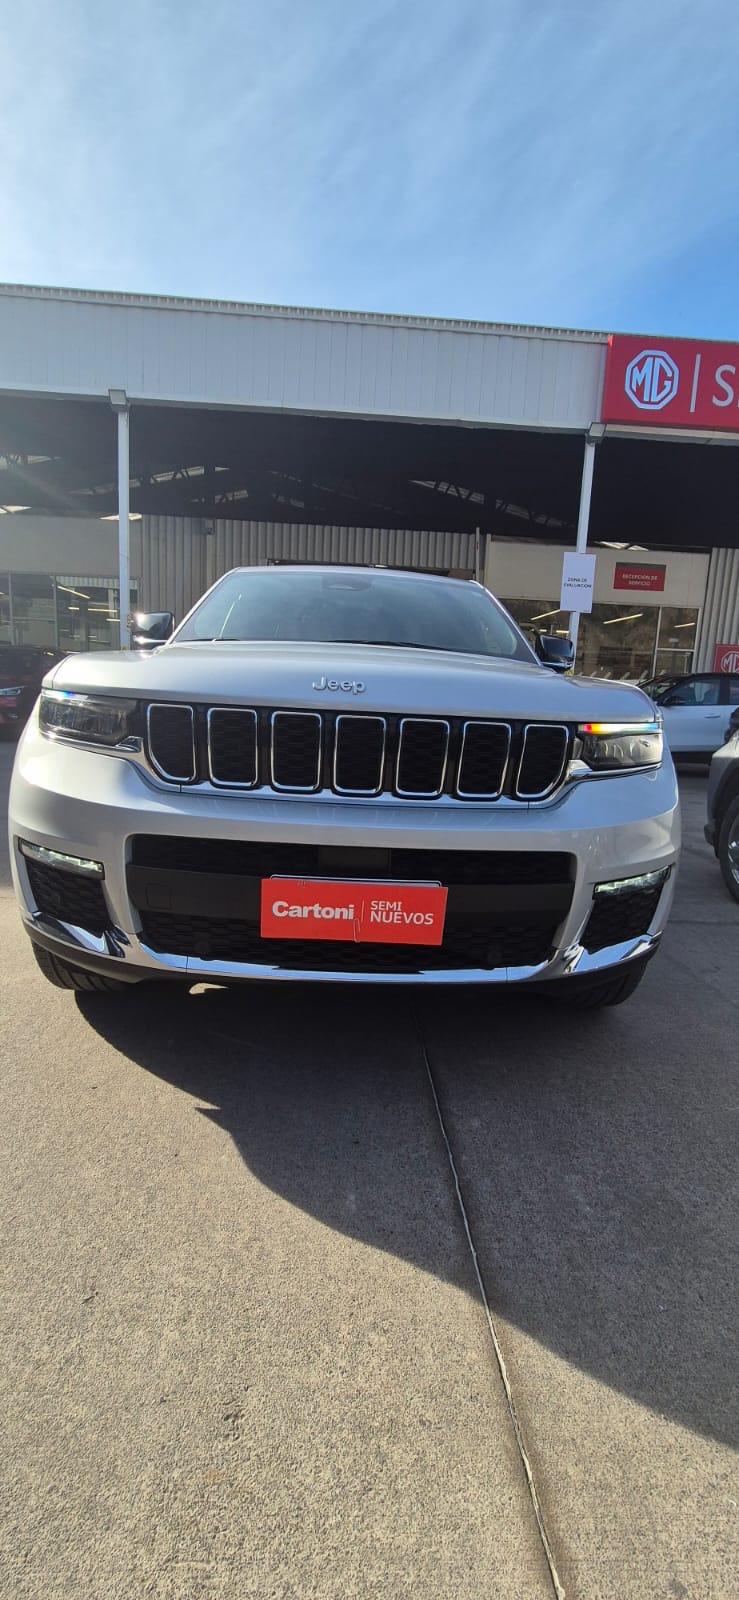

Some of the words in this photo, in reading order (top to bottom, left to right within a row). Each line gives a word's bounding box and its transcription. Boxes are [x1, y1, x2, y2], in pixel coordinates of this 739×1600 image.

[631, 356, 673, 403] MG
[711, 364, 739, 408] S
[312, 676, 366, 695] Jeep
[272, 901, 354, 920] Cartoni
[370, 901, 402, 911] SEMI
[370, 911, 433, 925] NUEVOS
